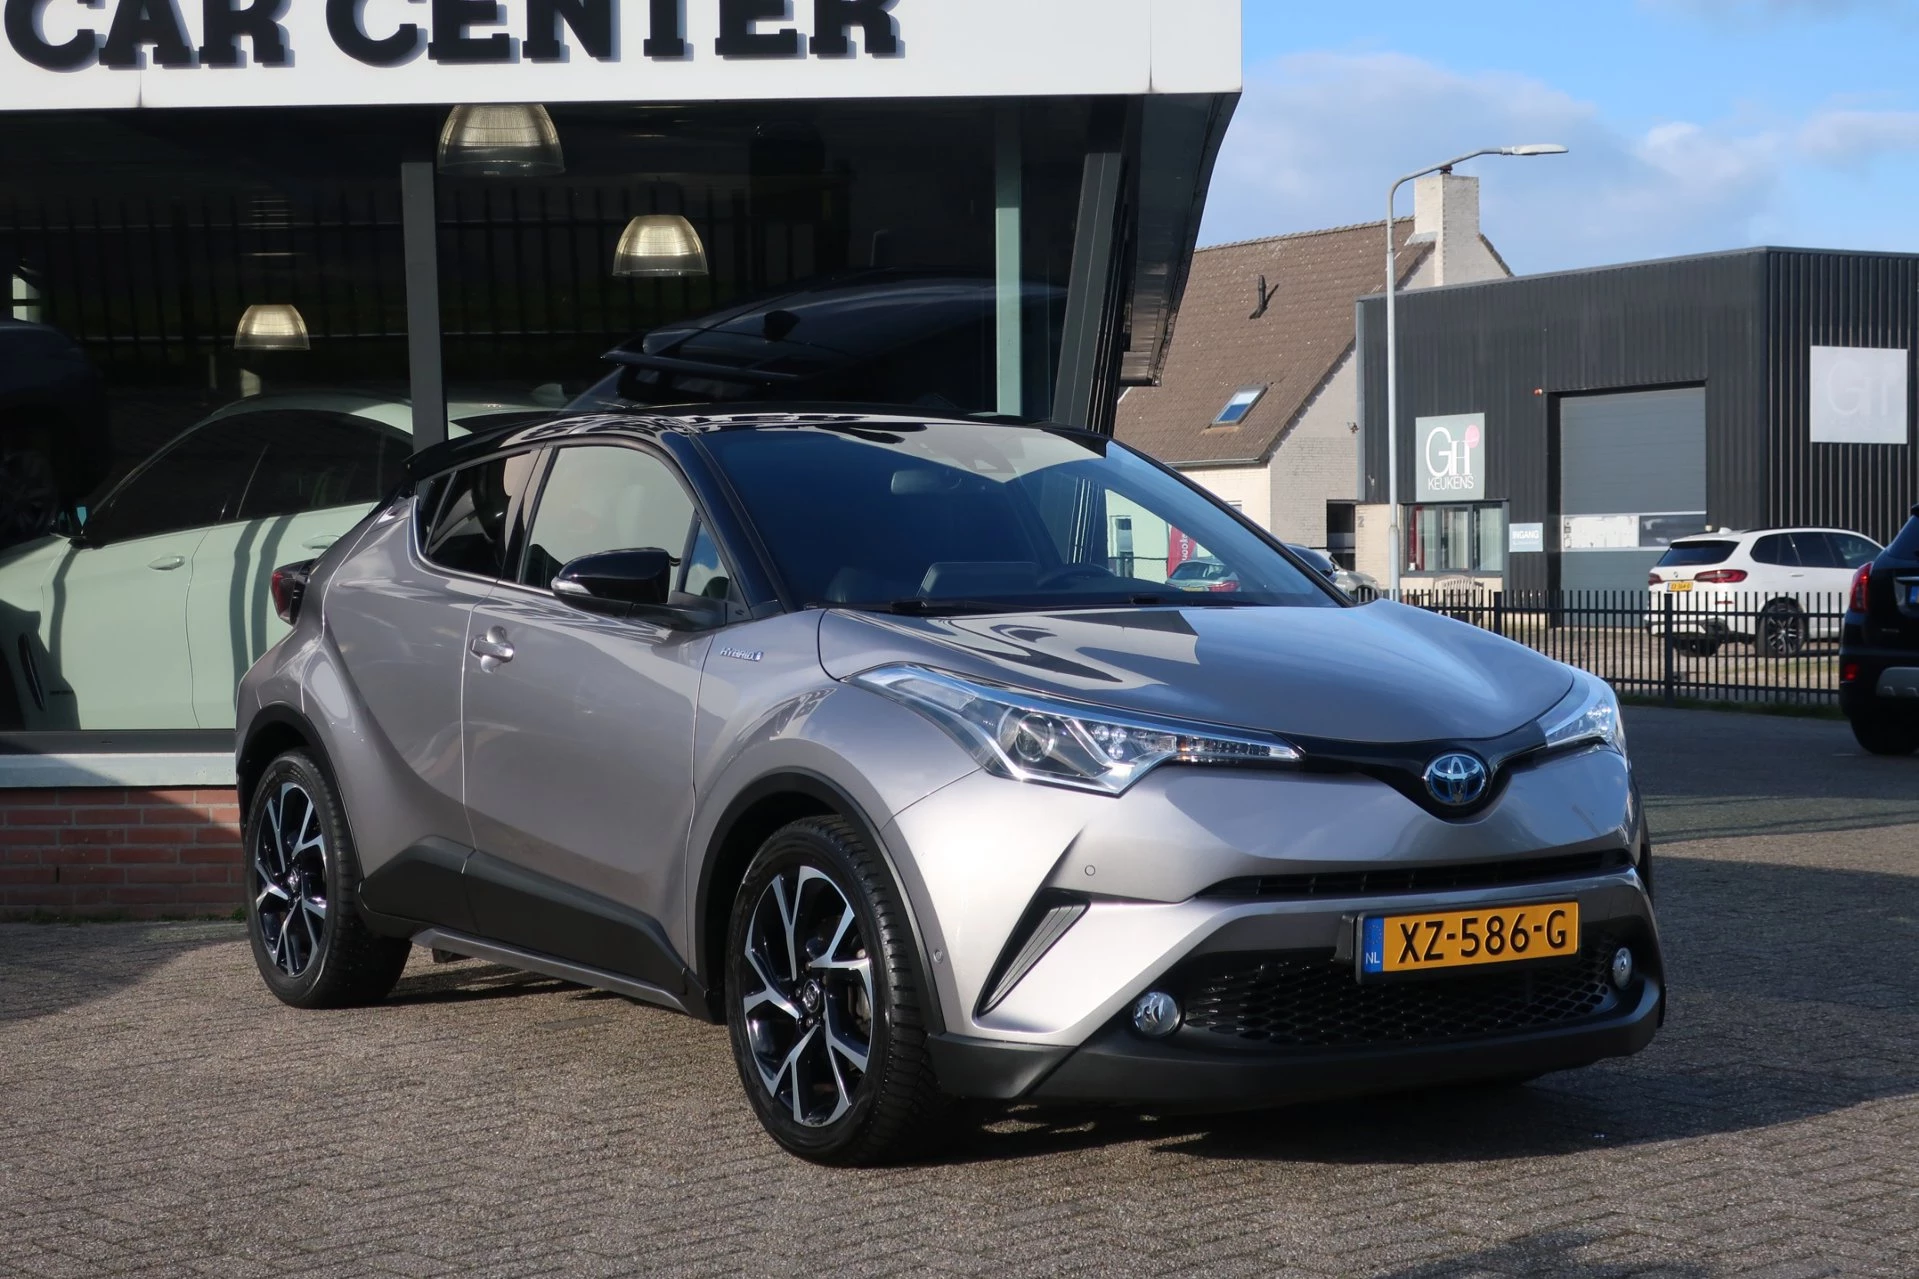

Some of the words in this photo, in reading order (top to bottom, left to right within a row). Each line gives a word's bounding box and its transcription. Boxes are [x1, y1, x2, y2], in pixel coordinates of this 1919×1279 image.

[4, 0, 292, 71] CAR
[1427, 475, 1474, 491] KEUKENS
[720, 647, 754, 660] HYBRID
[1397, 909, 1567, 965] XZ-586-G
[1364, 951, 1381, 965] NL
